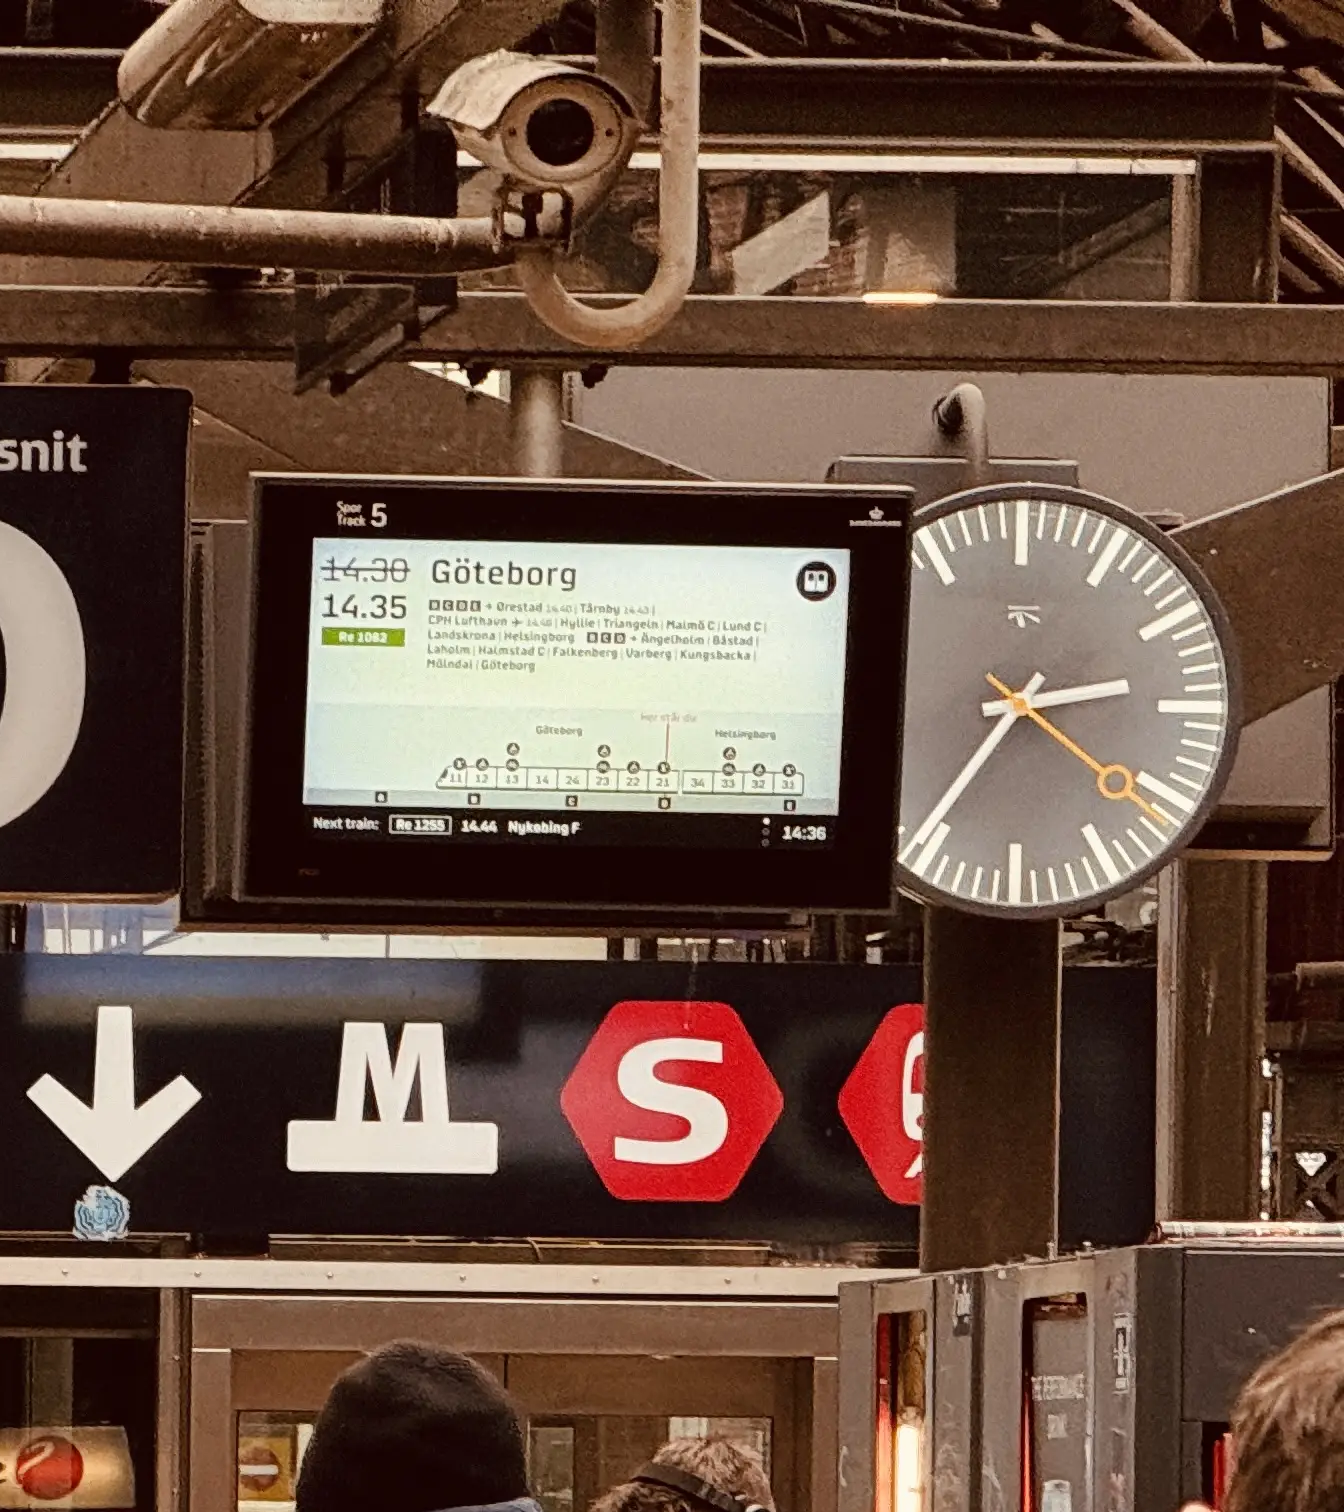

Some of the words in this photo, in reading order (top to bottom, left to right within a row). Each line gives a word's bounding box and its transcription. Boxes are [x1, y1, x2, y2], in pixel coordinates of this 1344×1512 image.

[336, 500, 362, 514] Spor
[371, 502, 388, 528] 5
[321, 556, 410, 583] 14.30
[432, 558, 577, 592] Göteborg
[321, 593, 407, 619] 14.35
[496, 601, 543, 613] Ørestad
[580, 602, 620, 616] Tårnby
[428, 615, 451, 626] CPH
[455, 615, 508, 627] Lufthavn
[560, 618, 595, 630] Hyllie
[604, 618, 659, 631] Triangeln
[666, 619, 705, 631] Malmö
[707, 620, 717, 631] C
[722, 621, 751, 632] Lund
[753, 621, 762, 632] C
[338, 631, 355, 643] Re
[427, 630, 496, 641] Landskrona
[504, 631, 575, 643] Helsingborg
[641, 632, 705, 646] Ängelholm
[712, 634, 753, 646] Båstad
[427, 643, 471, 655] Laholm
[478, 645, 534, 656] Halmstad
[537, 646, 546, 657] C
[552, 646, 618, 660] Falkenberg
[625, 648, 672, 660] Varberg
[680, 649, 751, 662] Kungsbacka
[426, 658, 473, 670] Mölndal
[481, 659, 536, 673] Göteborg
[313, 816, 344, 830] Next
[345, 816, 380, 831] train:
[396, 818, 412, 830] Re
[782, 825, 827, 841] 14:36
[614, 1036, 730, 1165] S
